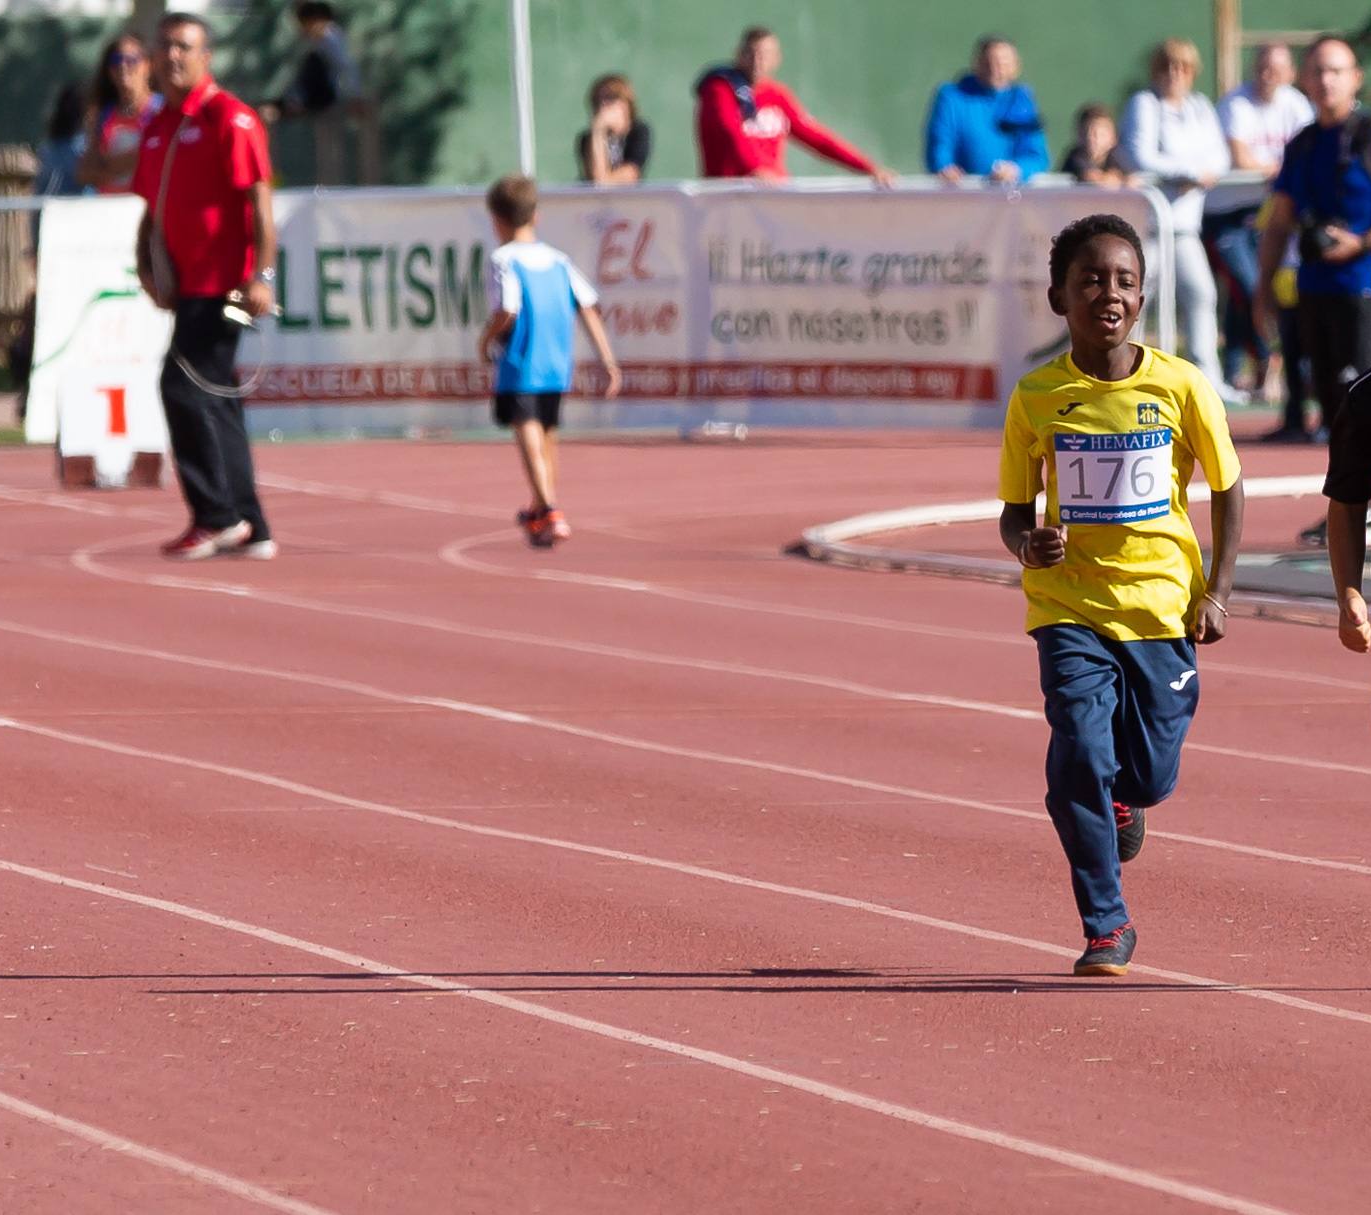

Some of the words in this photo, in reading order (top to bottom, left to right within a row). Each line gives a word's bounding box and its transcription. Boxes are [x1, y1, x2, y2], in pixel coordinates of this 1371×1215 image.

[596, 218, 652, 285] El
[740, 238, 852, 285] Hazte
[862, 243, 989, 299] grande
[275, 240, 487, 330] LETISM
[710, 311, 775, 345] con
[787, 307, 950, 345] nosotros
[95, 384, 127, 437] 1
[1090, 431, 1166, 451] HEMAFIX
[1068, 455, 1156, 500] 176
[1071, 510, 1098, 519] Central
[1137, 508, 1147, 517] de
